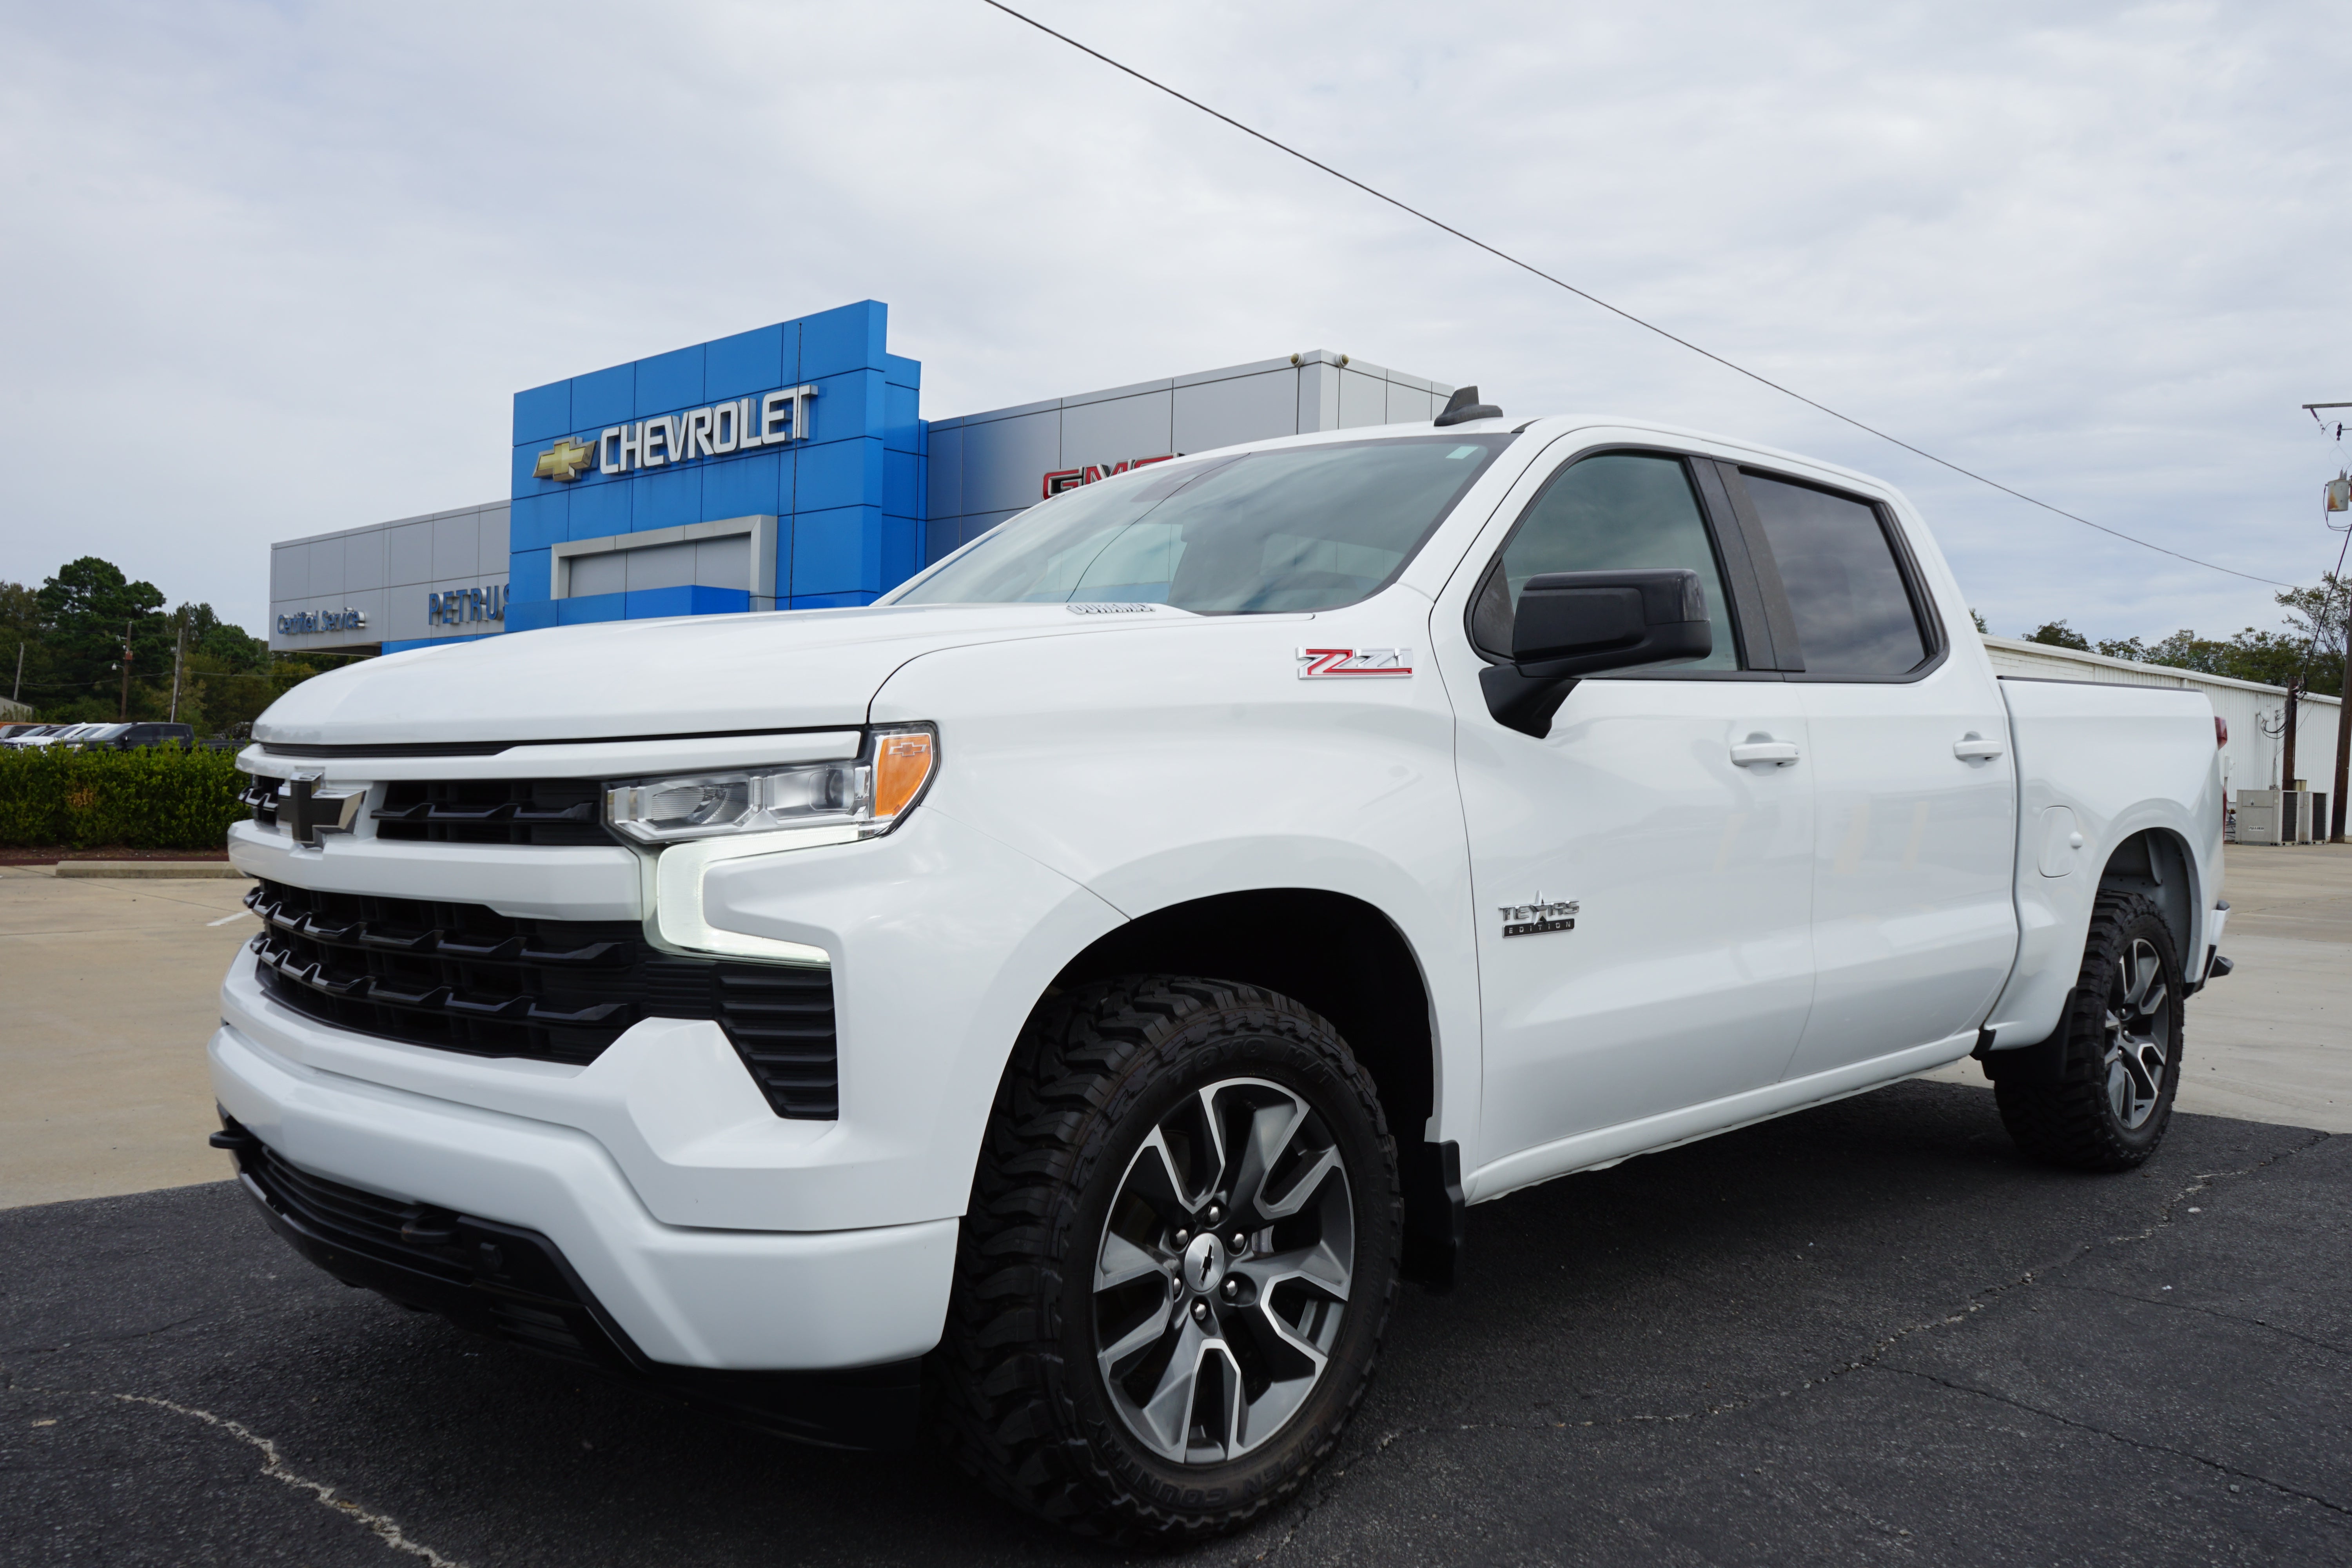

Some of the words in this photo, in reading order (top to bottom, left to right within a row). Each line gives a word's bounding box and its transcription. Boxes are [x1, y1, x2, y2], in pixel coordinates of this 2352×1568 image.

[600, 385, 818, 475] CHEVROLET
[278, 610, 319, 634] Certified
[321, 607, 365, 631] Service
[1296, 646, 1414, 680] Z71
[1168, 1037, 1265, 1084] TOYO
[1281, 1045, 1339, 1088] M/T
[1087, 1419, 1228, 1506] COUNTRY
[1243, 1423, 1320, 1496] OPEN
